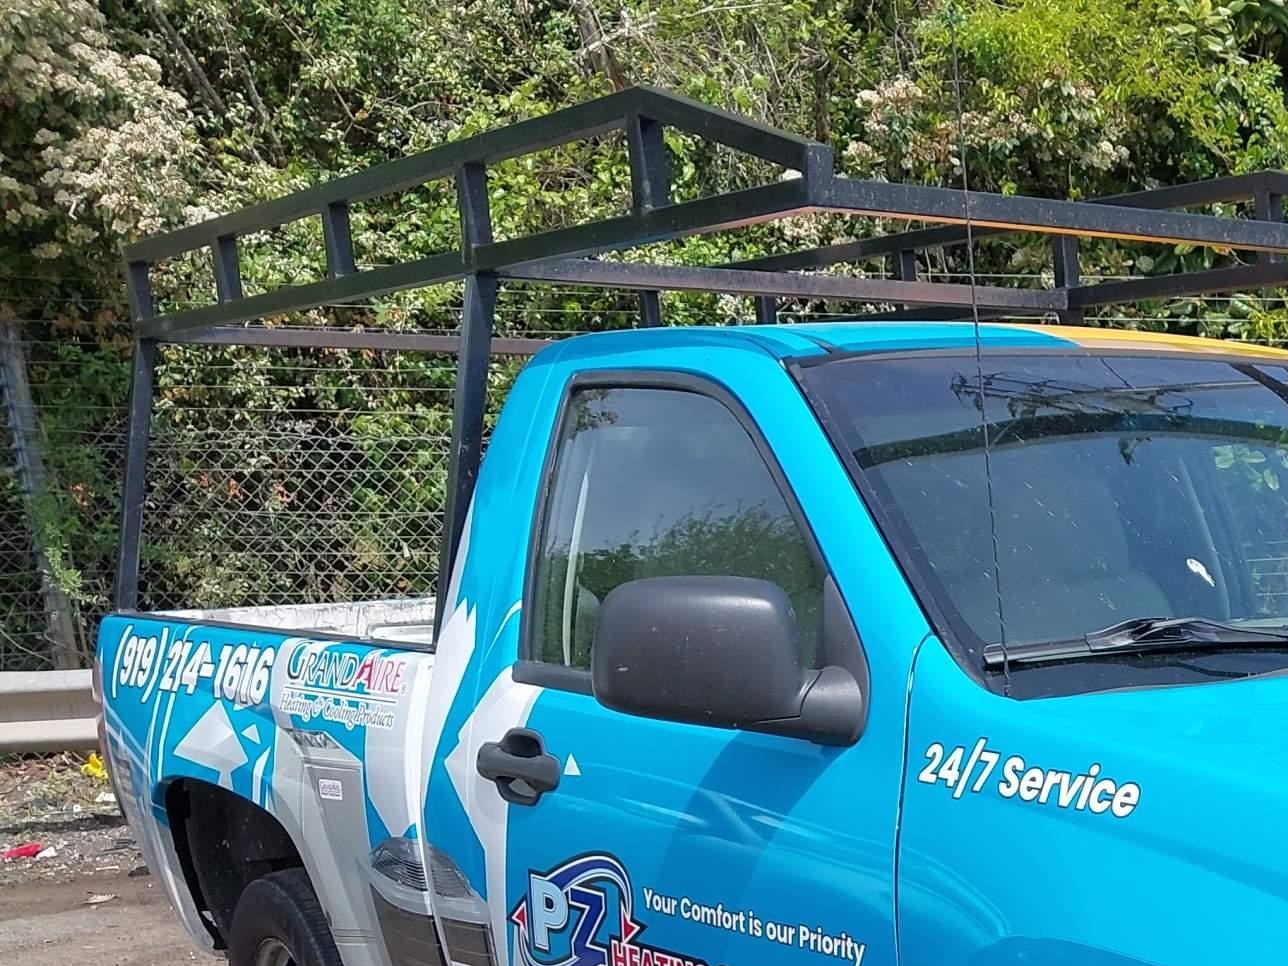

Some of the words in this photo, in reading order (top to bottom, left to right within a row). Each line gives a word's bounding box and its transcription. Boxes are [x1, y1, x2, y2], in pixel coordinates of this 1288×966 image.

[112, 624, 169, 703] (919)
[159, 638, 275, 705] 214-1616
[280, 693, 312, 720] Heating
[323, 698, 357, 728] Cooling
[356, 703, 395, 728] Products
[918, 737, 1000, 799] 24/7
[998, 755, 1141, 818] Service
[642, 887, 677, 916] Your
[680, 897, 746, 934] Comfort
[748, 911, 763, 938] is
[765, 921, 796, 946] our
